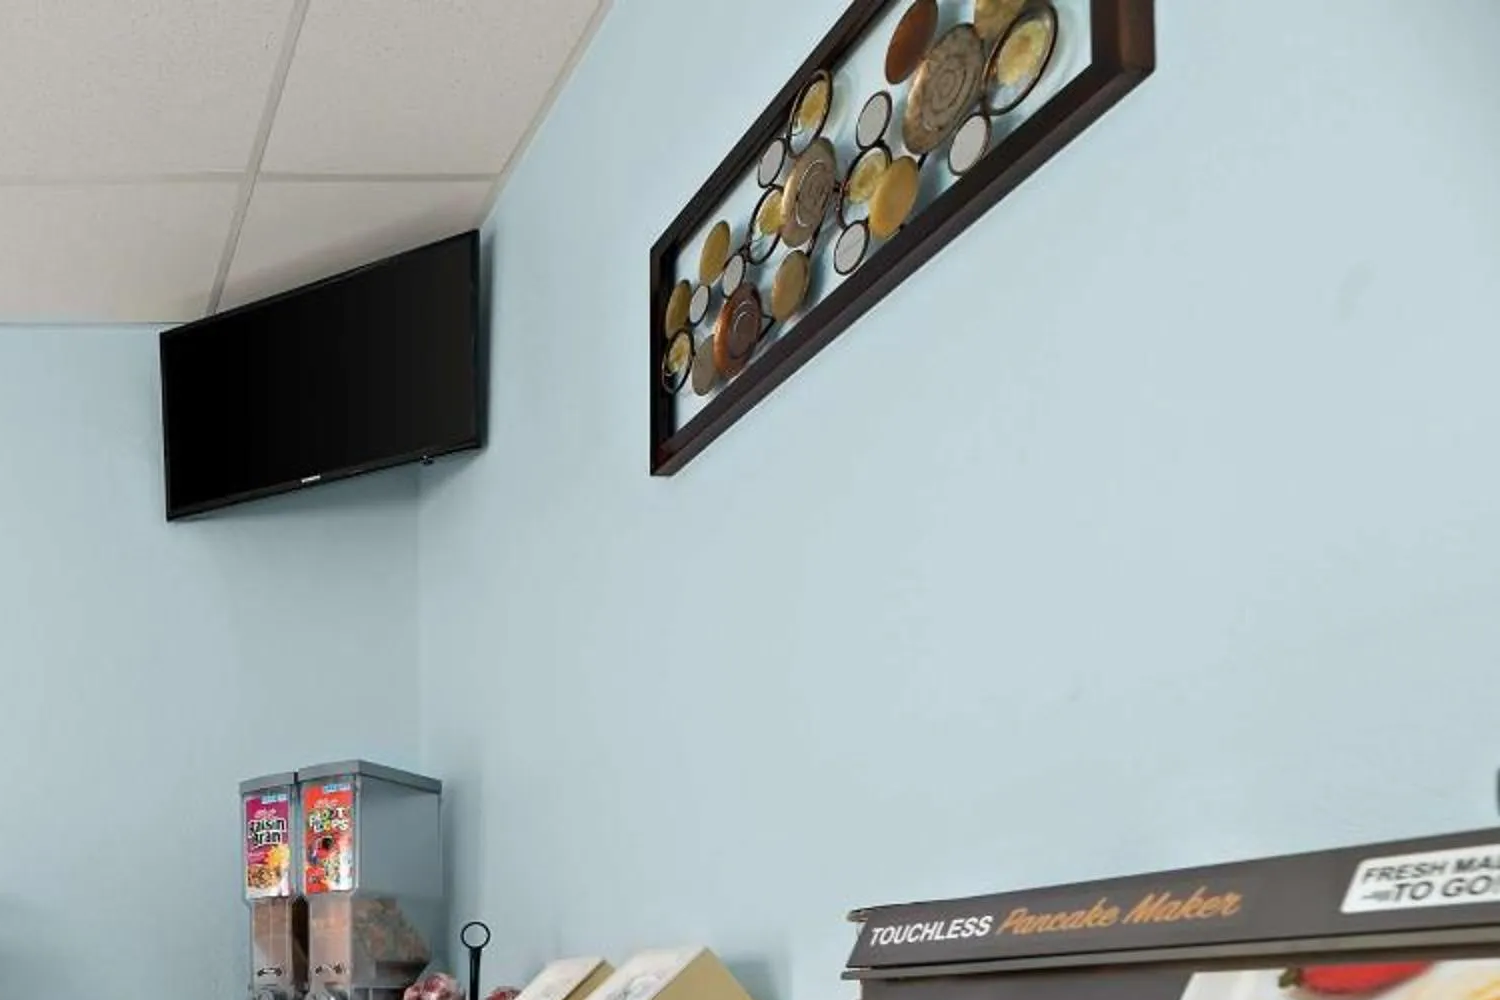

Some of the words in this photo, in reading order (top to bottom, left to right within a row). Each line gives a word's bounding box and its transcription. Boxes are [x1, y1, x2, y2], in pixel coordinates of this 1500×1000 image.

[1361, 860, 1449, 885] FRESH
[1394, 880, 1434, 902] TO
[1441, 874, 1493, 898] GO
[869, 915, 993, 947] TOUCHLESS
[996, 897, 1120, 936] Pancake
[1122, 886, 1242, 925] Maker
